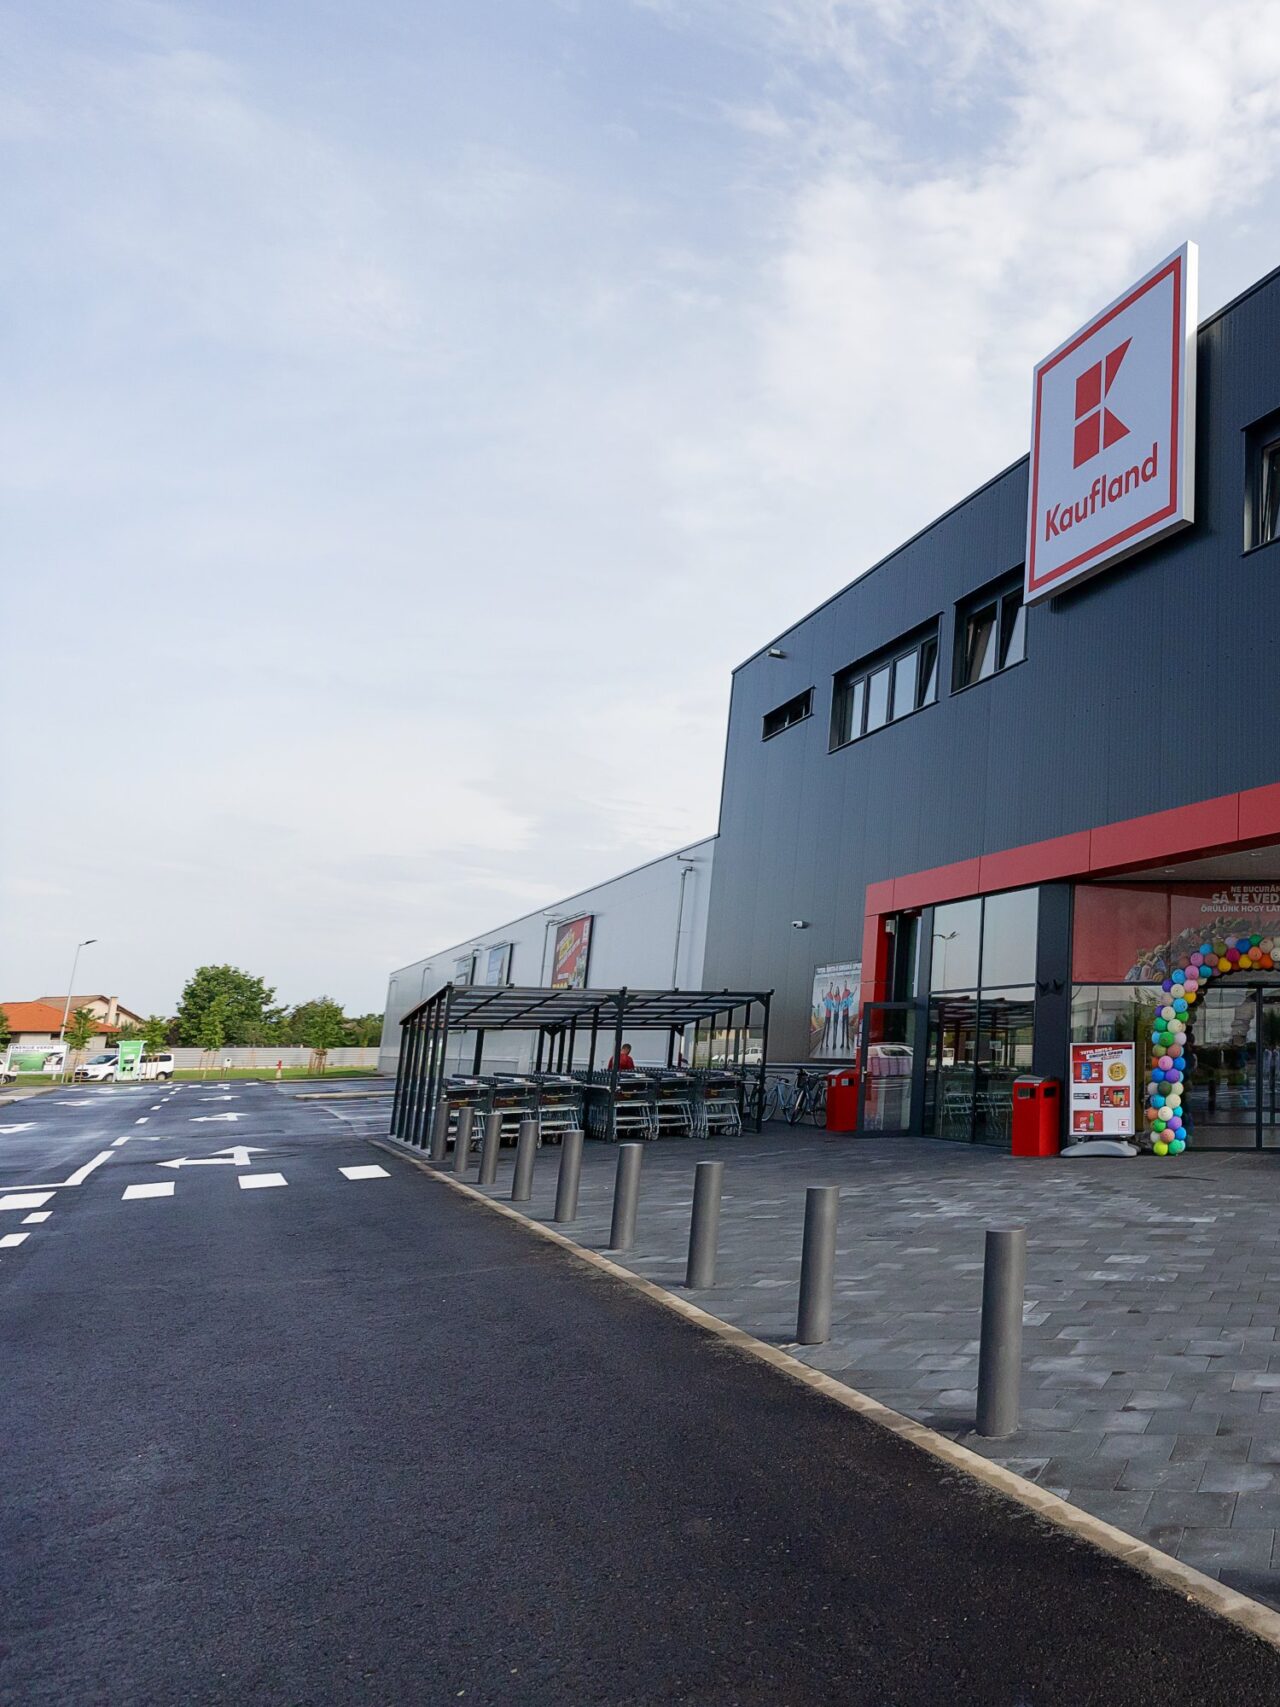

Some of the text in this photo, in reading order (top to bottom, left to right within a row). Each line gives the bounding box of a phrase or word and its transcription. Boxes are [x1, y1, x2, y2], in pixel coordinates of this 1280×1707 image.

[1045, 441, 1159, 542] Kaufland
[1212, 891, 1229, 903] SĂ
[1233, 893, 1249, 903] TE
